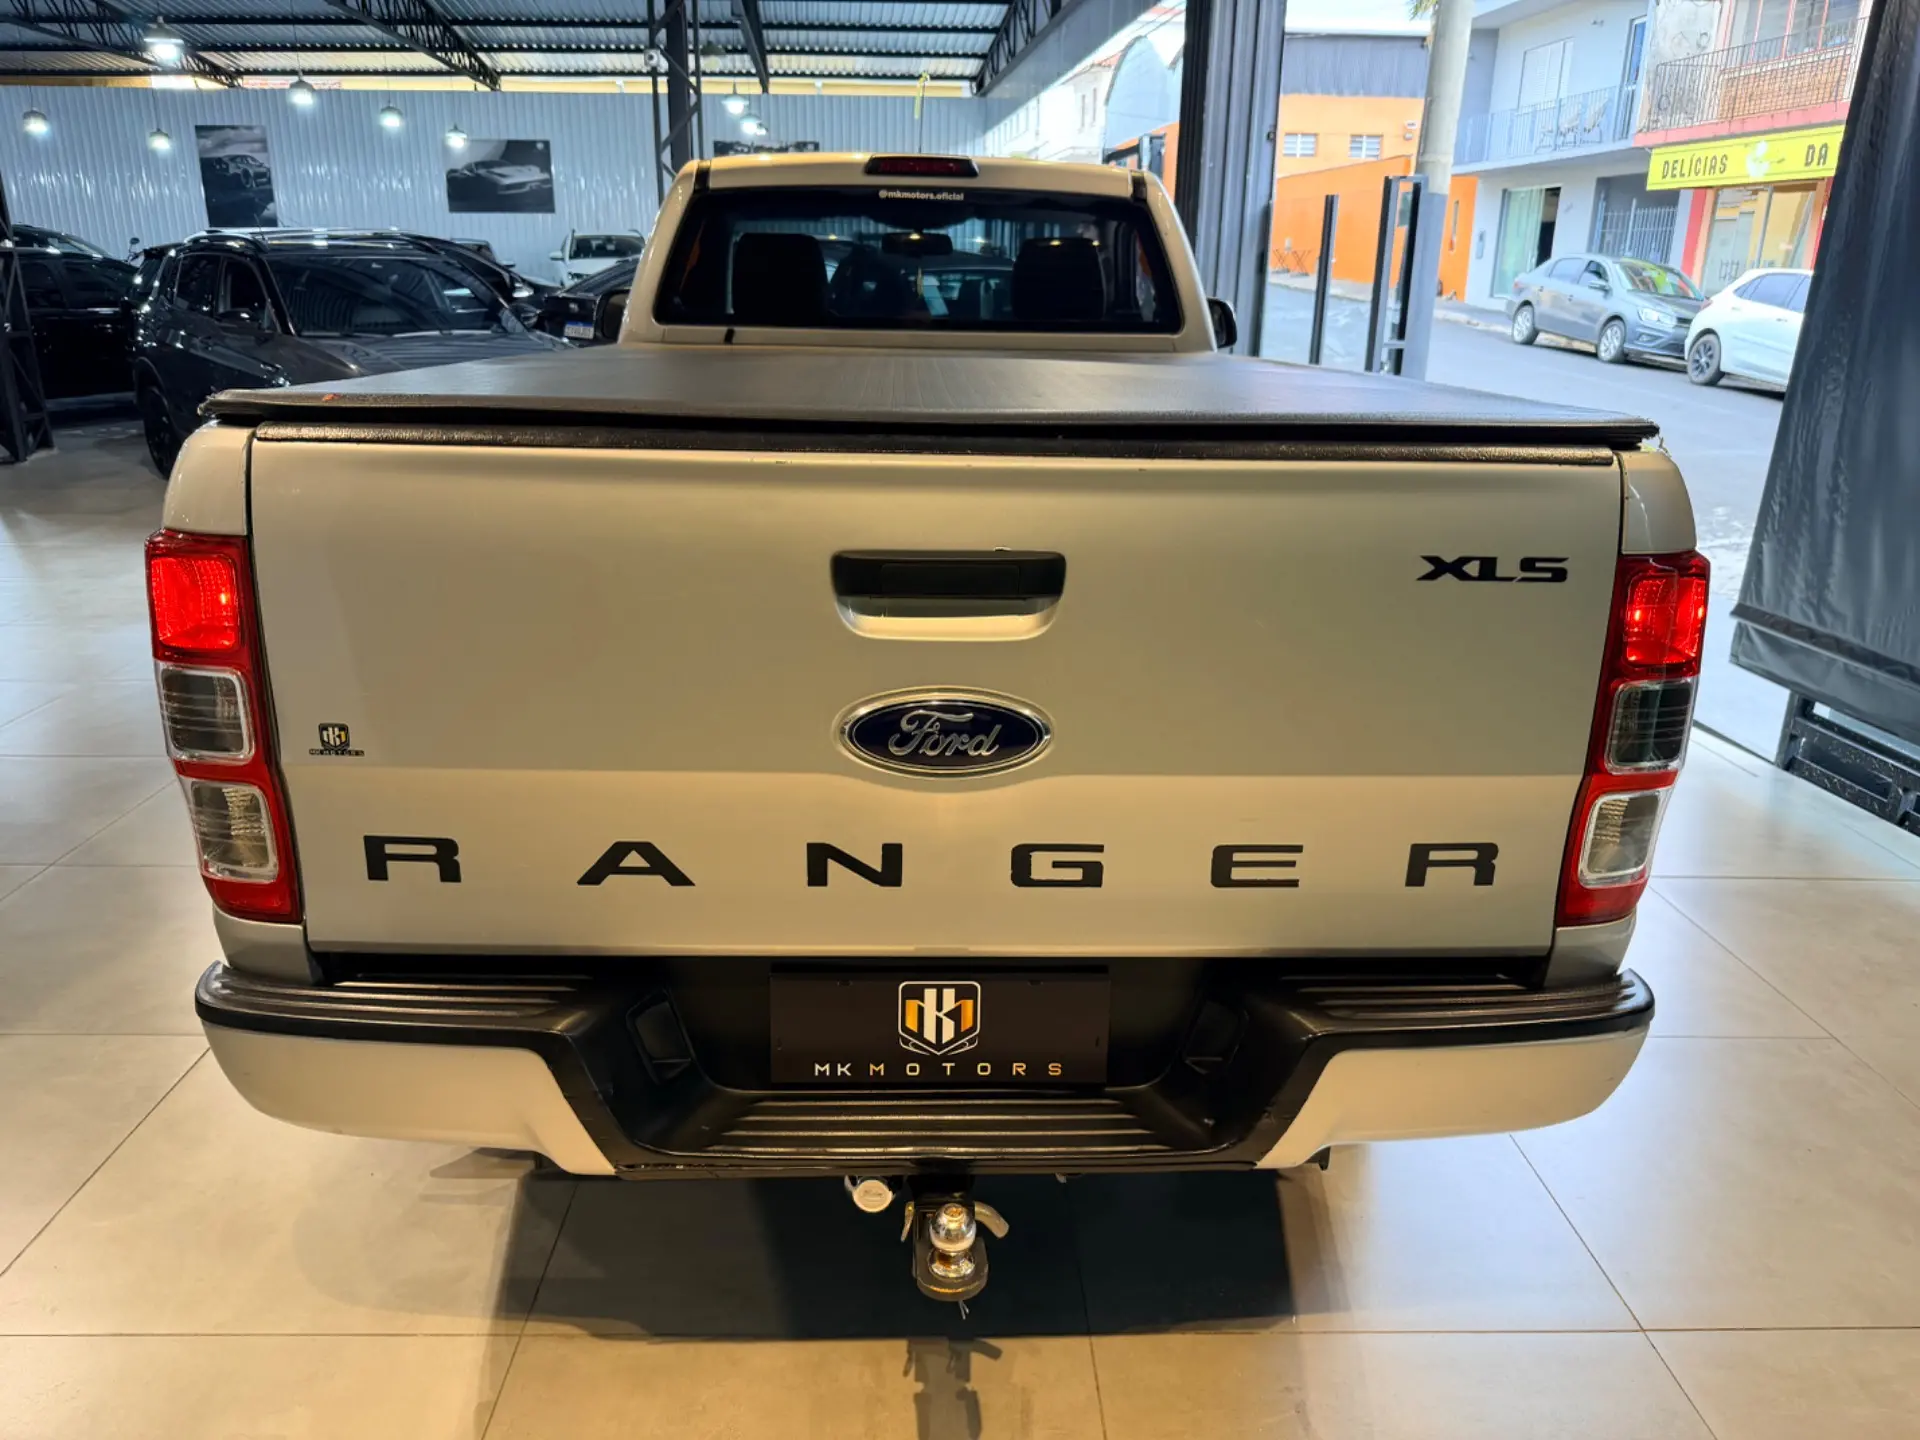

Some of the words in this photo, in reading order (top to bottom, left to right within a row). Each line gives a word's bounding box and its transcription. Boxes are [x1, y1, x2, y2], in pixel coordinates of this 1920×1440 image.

[1661, 154, 1728, 179] DELÍCIAS
[1804, 143, 1829, 167] DA
[879, 189, 964, 201] @mkmotors.oficial
[1416, 555, 1570, 583] XLS
[888, 709, 1002, 757] Ford
[363, 835, 1499, 887] RANGER
[869, 1062, 1062, 1076] MOTORS
